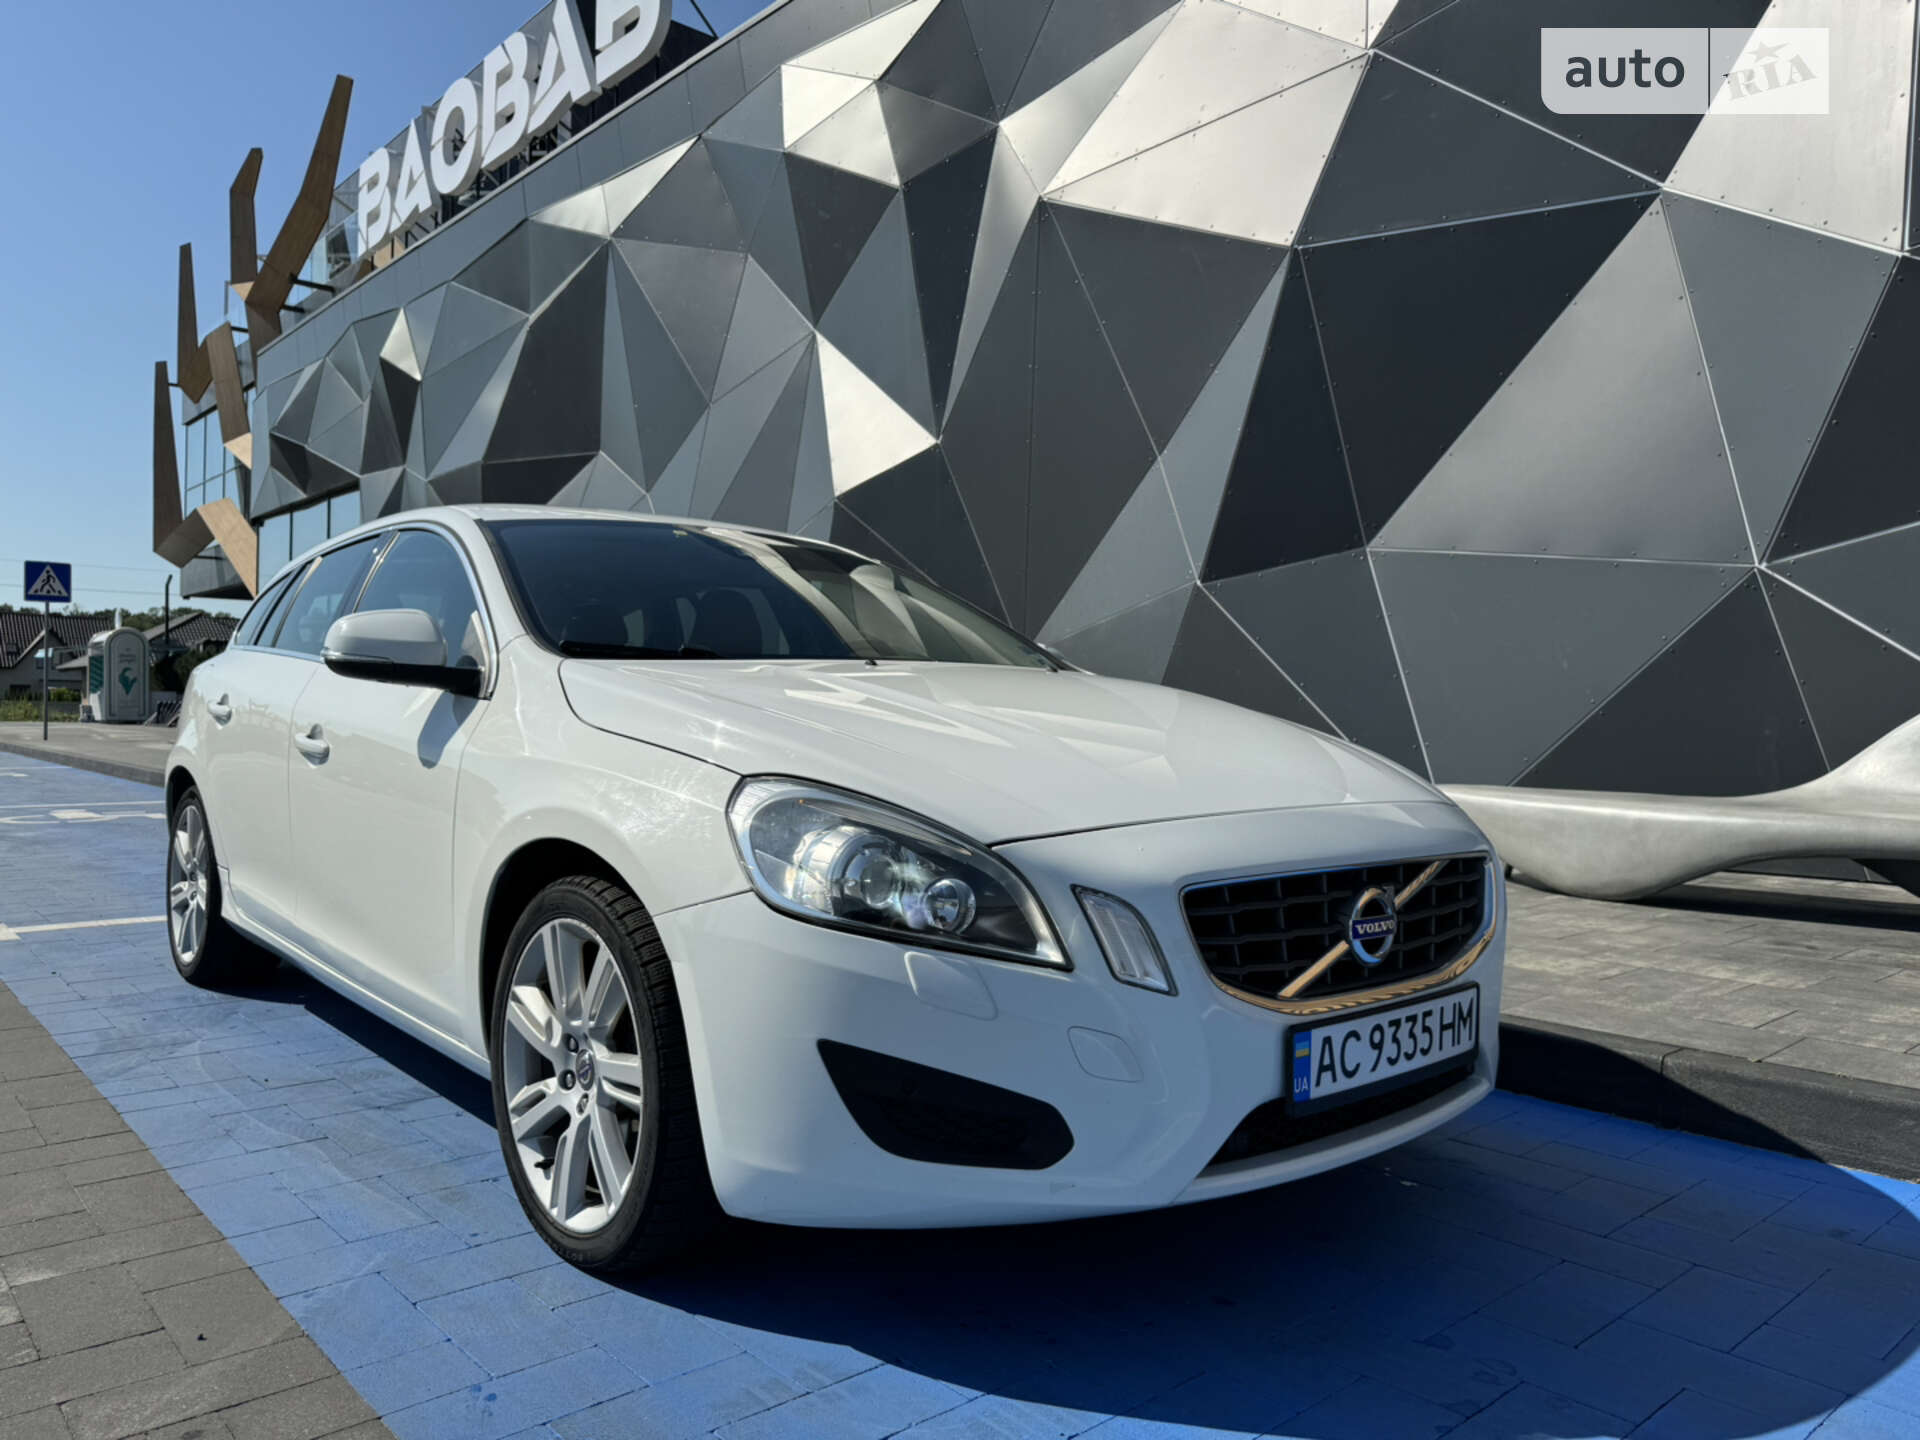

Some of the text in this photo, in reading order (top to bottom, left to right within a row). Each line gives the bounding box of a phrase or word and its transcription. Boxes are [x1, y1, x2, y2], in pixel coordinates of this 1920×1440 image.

[357, 0, 668, 257] BAOBAB
[1355, 919, 1396, 935] VOLVO
[1293, 1078, 1310, 1094] UA
